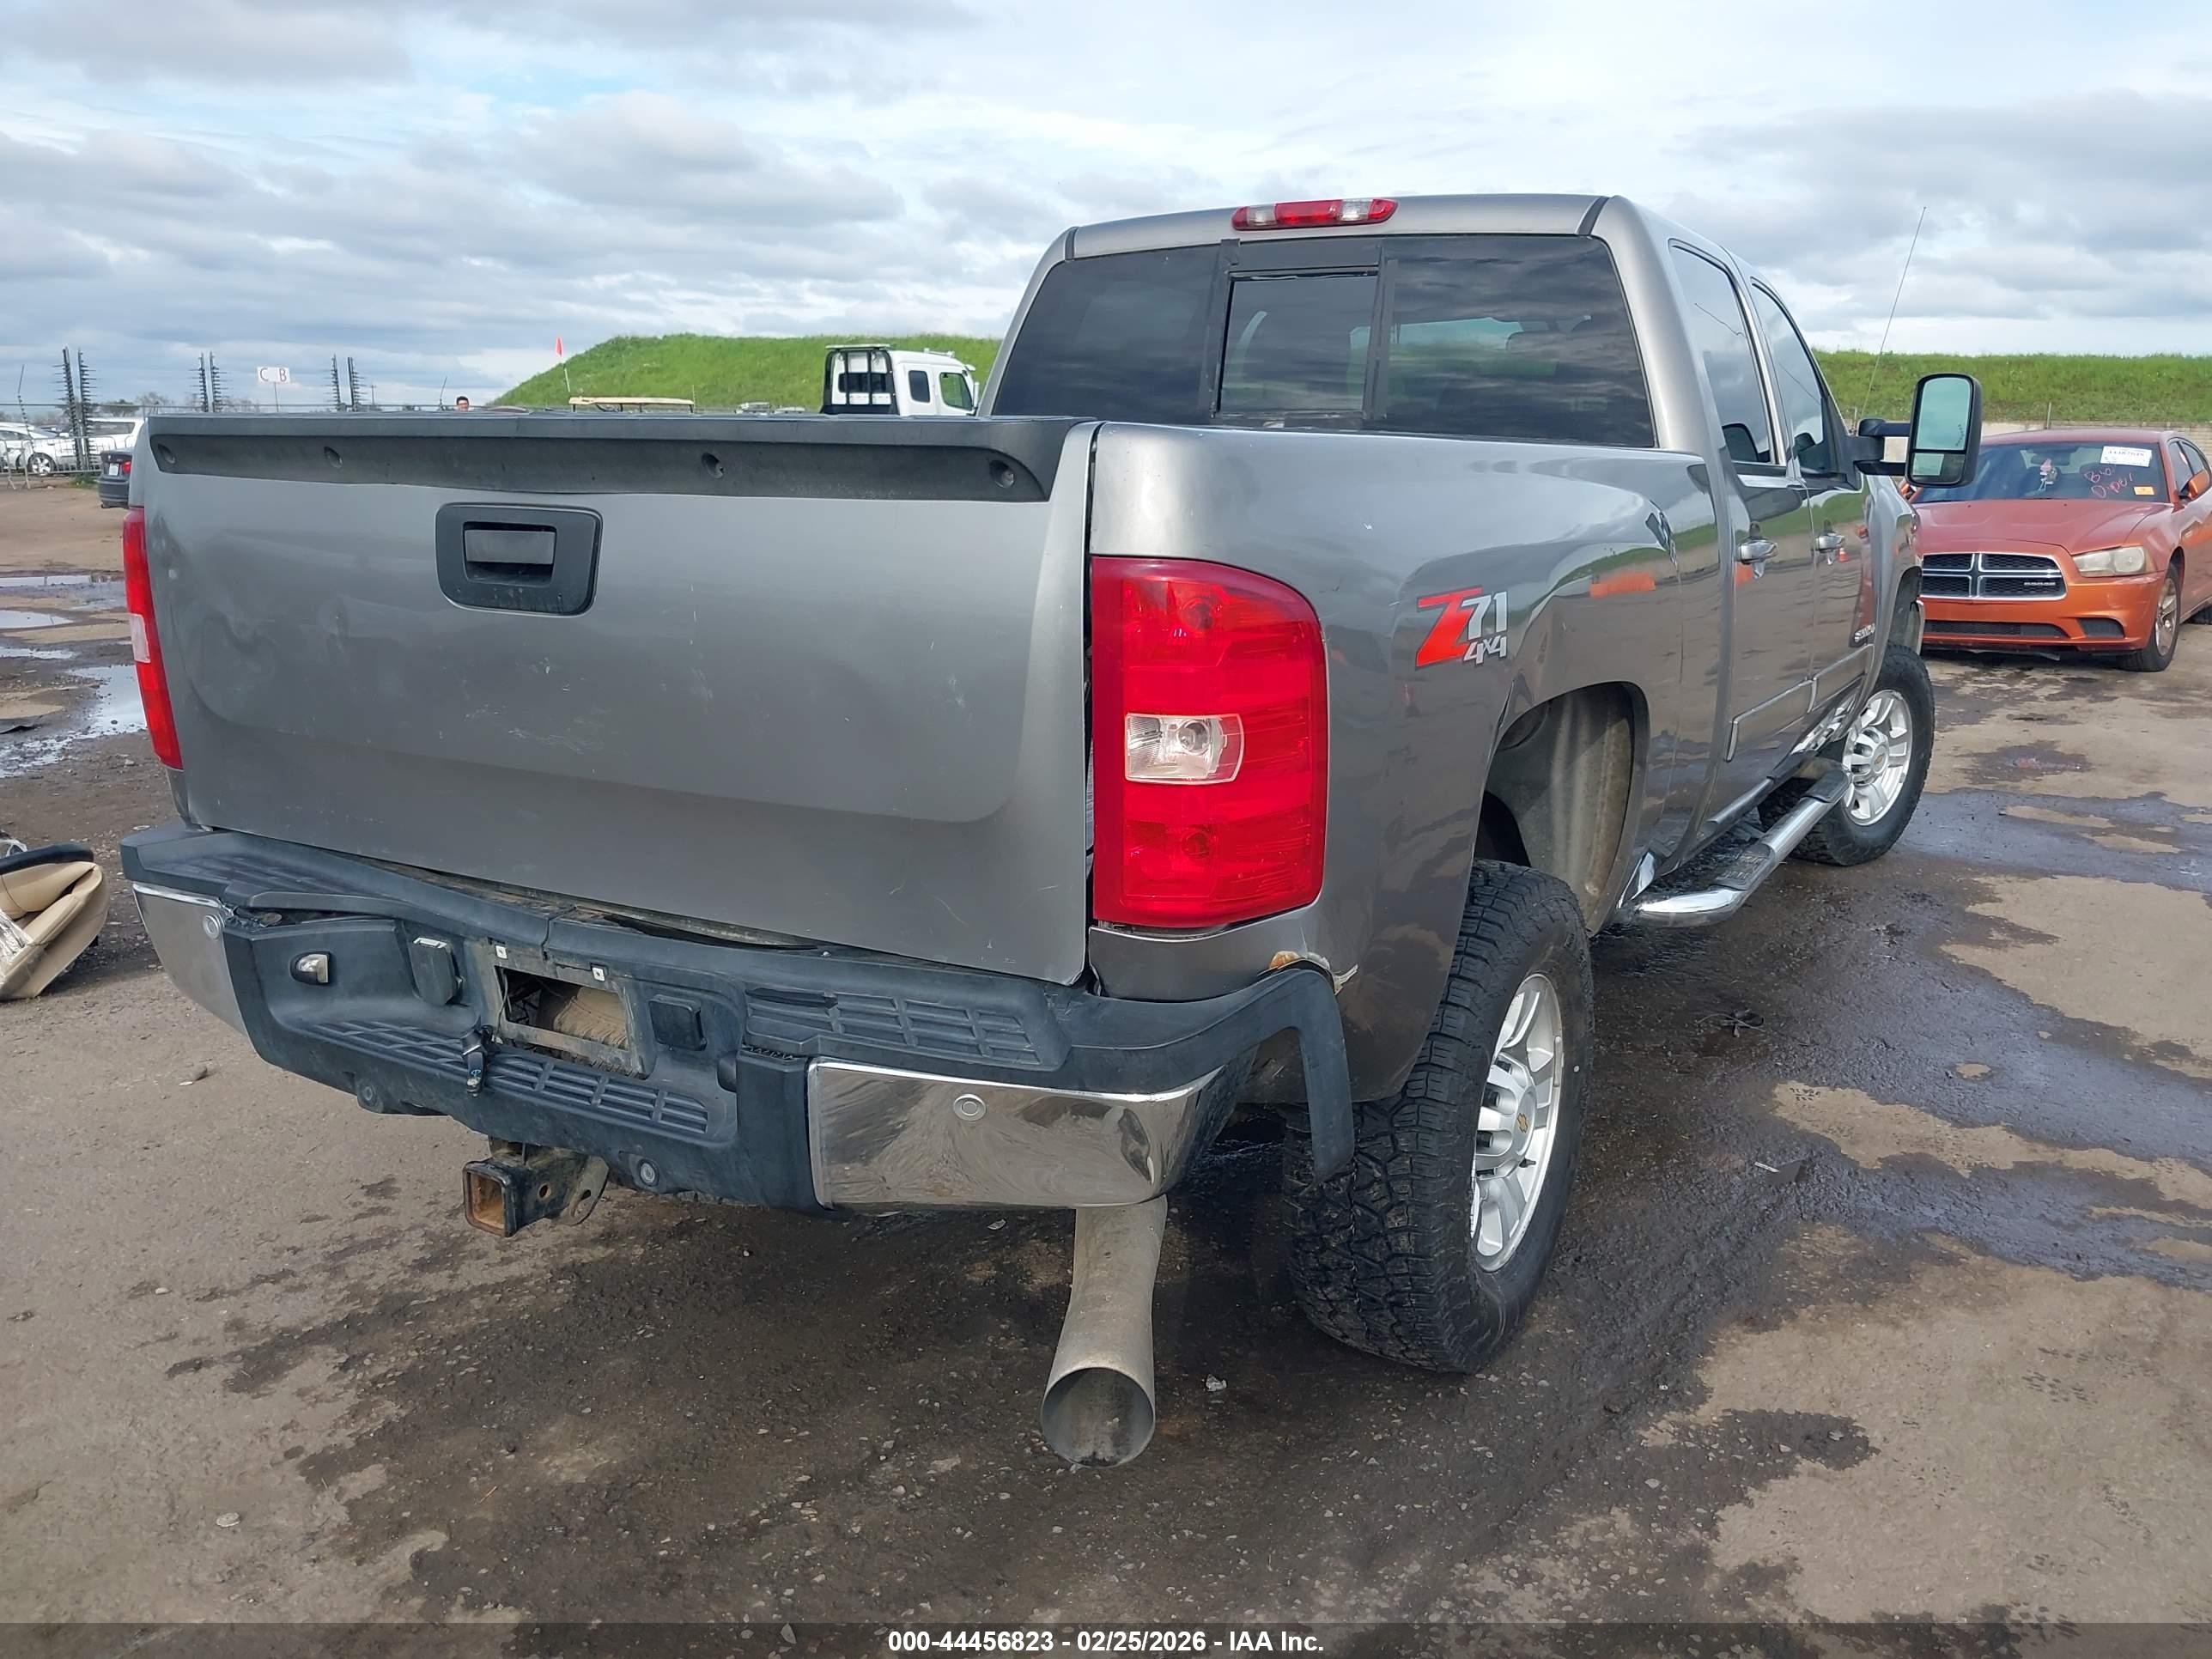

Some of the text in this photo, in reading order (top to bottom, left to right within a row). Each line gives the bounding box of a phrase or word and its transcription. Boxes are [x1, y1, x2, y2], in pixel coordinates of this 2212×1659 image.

[259, 367, 288, 382] C B
[1416, 586, 1509, 669] Z71
